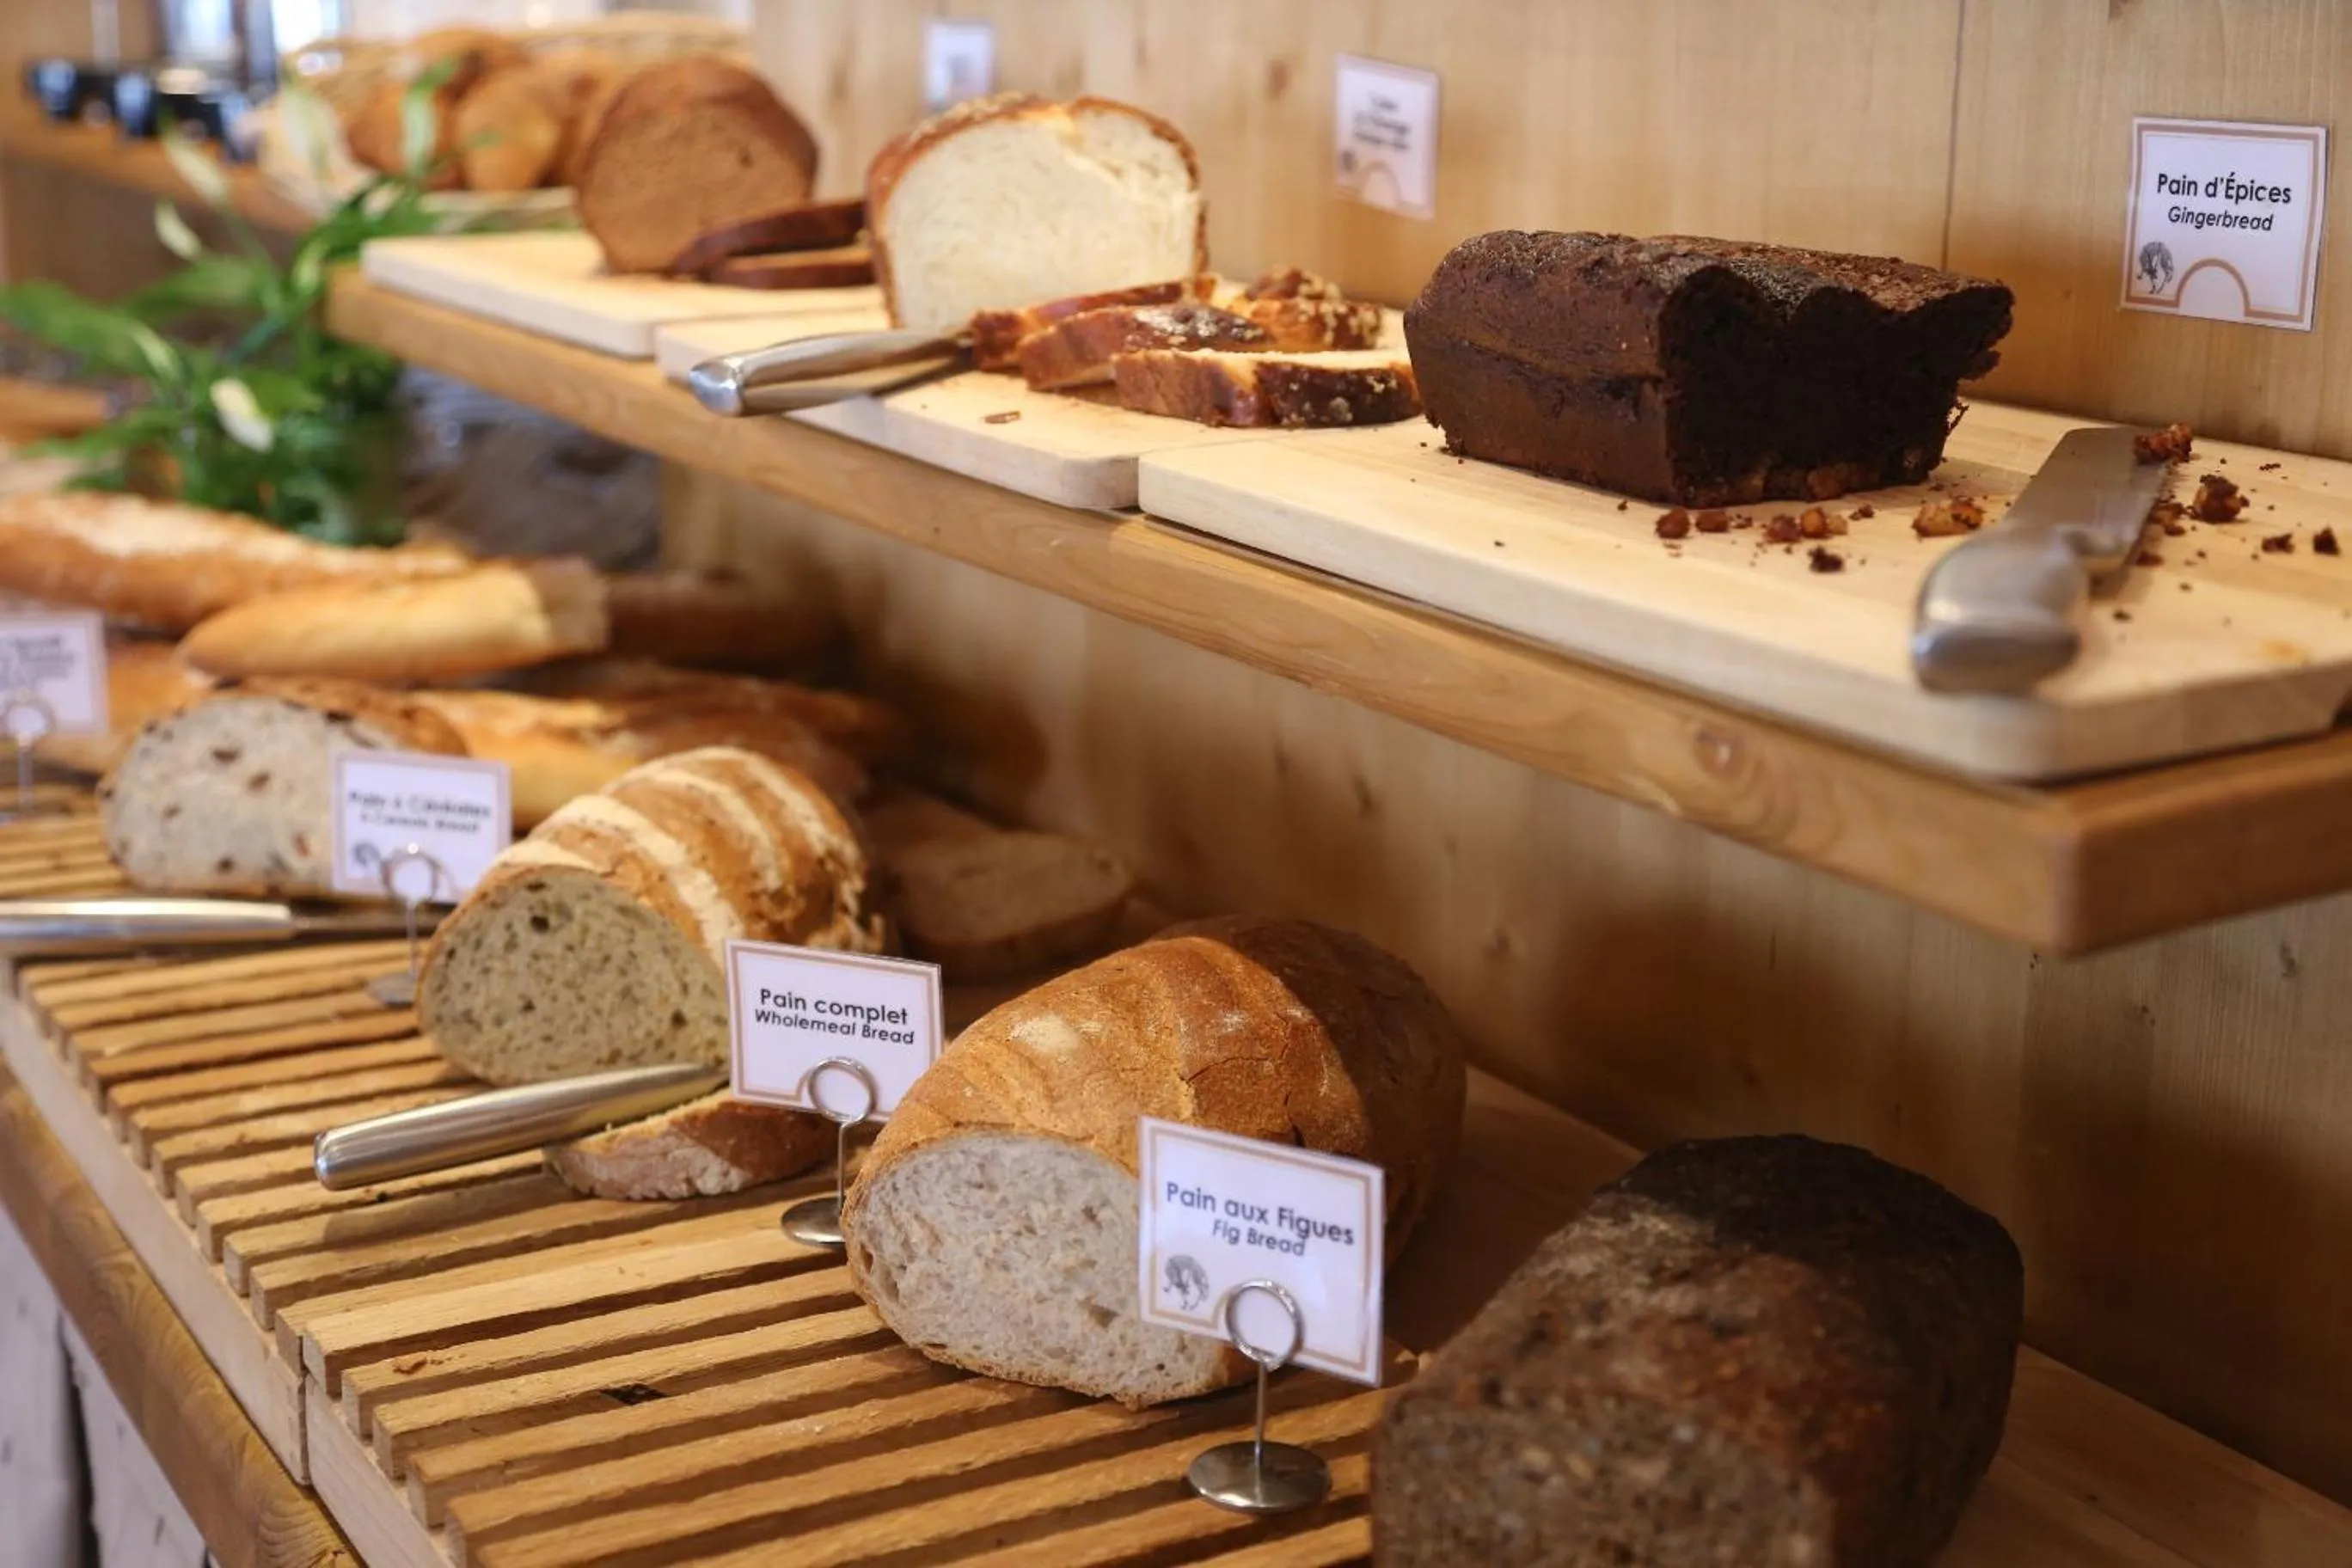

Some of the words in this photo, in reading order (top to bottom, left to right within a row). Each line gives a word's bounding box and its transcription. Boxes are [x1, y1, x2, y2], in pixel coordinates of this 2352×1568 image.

[2157, 173, 2198, 197] Pain
[2204, 172, 2292, 205] d'Épices
[2168, 206, 2274, 231] Gingerbread
[760, 988, 806, 1012] Pain
[814, 999, 908, 1026] complet
[755, 1009, 855, 1035] Wholemeal
[861, 1025, 915, 1044] Bread
[1167, 1181, 1216, 1212] Pain
[1224, 1199, 1269, 1225] aux
[1277, 1207, 1354, 1245] Figues
[1212, 1220, 1240, 1245] Fig
[1246, 1229, 1306, 1257] Bread
